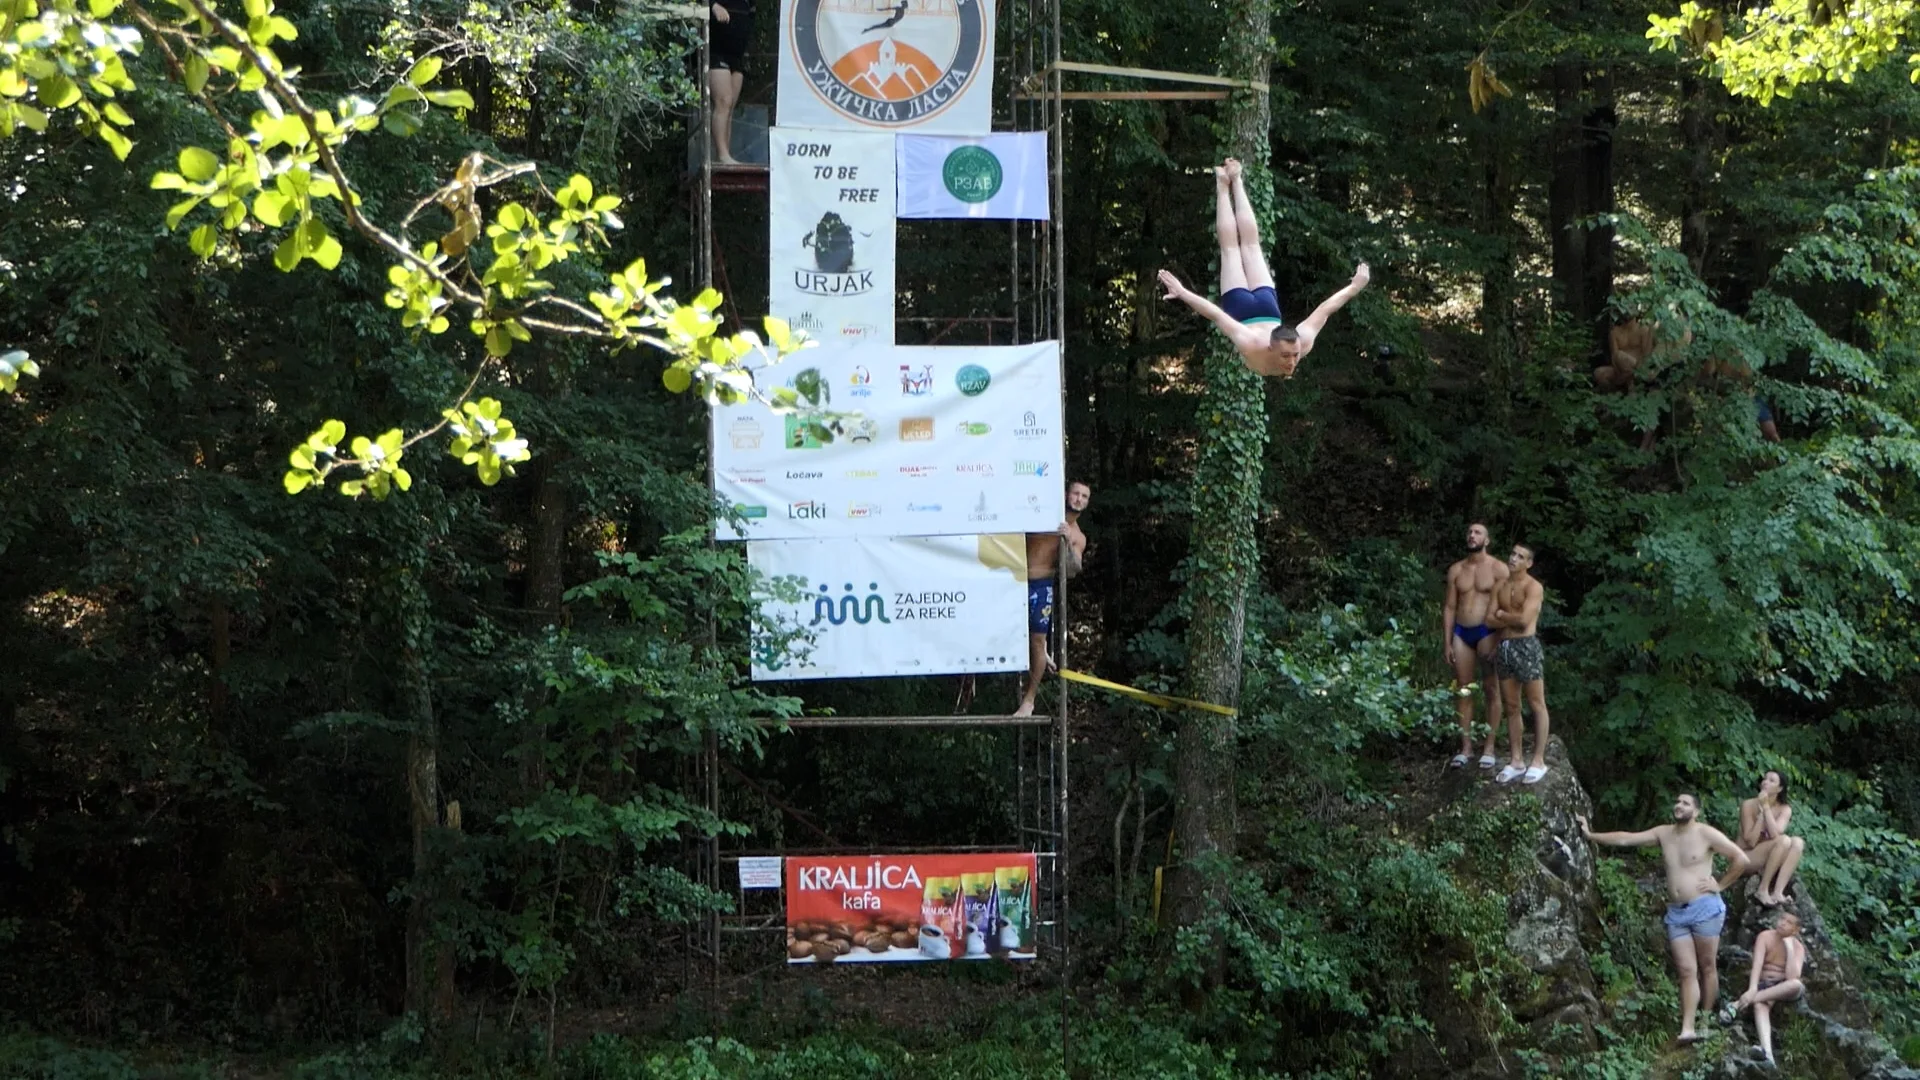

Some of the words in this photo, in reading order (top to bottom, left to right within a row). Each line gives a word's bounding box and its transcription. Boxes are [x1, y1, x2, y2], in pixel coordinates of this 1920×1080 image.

[808, 59, 898, 120] УЖИЧКА
[908, 69, 967, 119] ЛАСТА
[787, 143, 831, 157] BORN
[813, 166, 833, 179] TO
[837, 166, 858, 180] BE
[838, 188, 880, 202] FREE
[795, 270, 873, 292] URJAK
[1013, 428, 1047, 436] SRETEN
[788, 500, 826, 519] Laki
[895, 591, 966, 604] ZAJEDNO
[895, 608, 915, 619] ZA
[919, 607, 956, 619] REKE
[800, 861, 922, 890] KRALJICA
[843, 891, 881, 909] kafa
